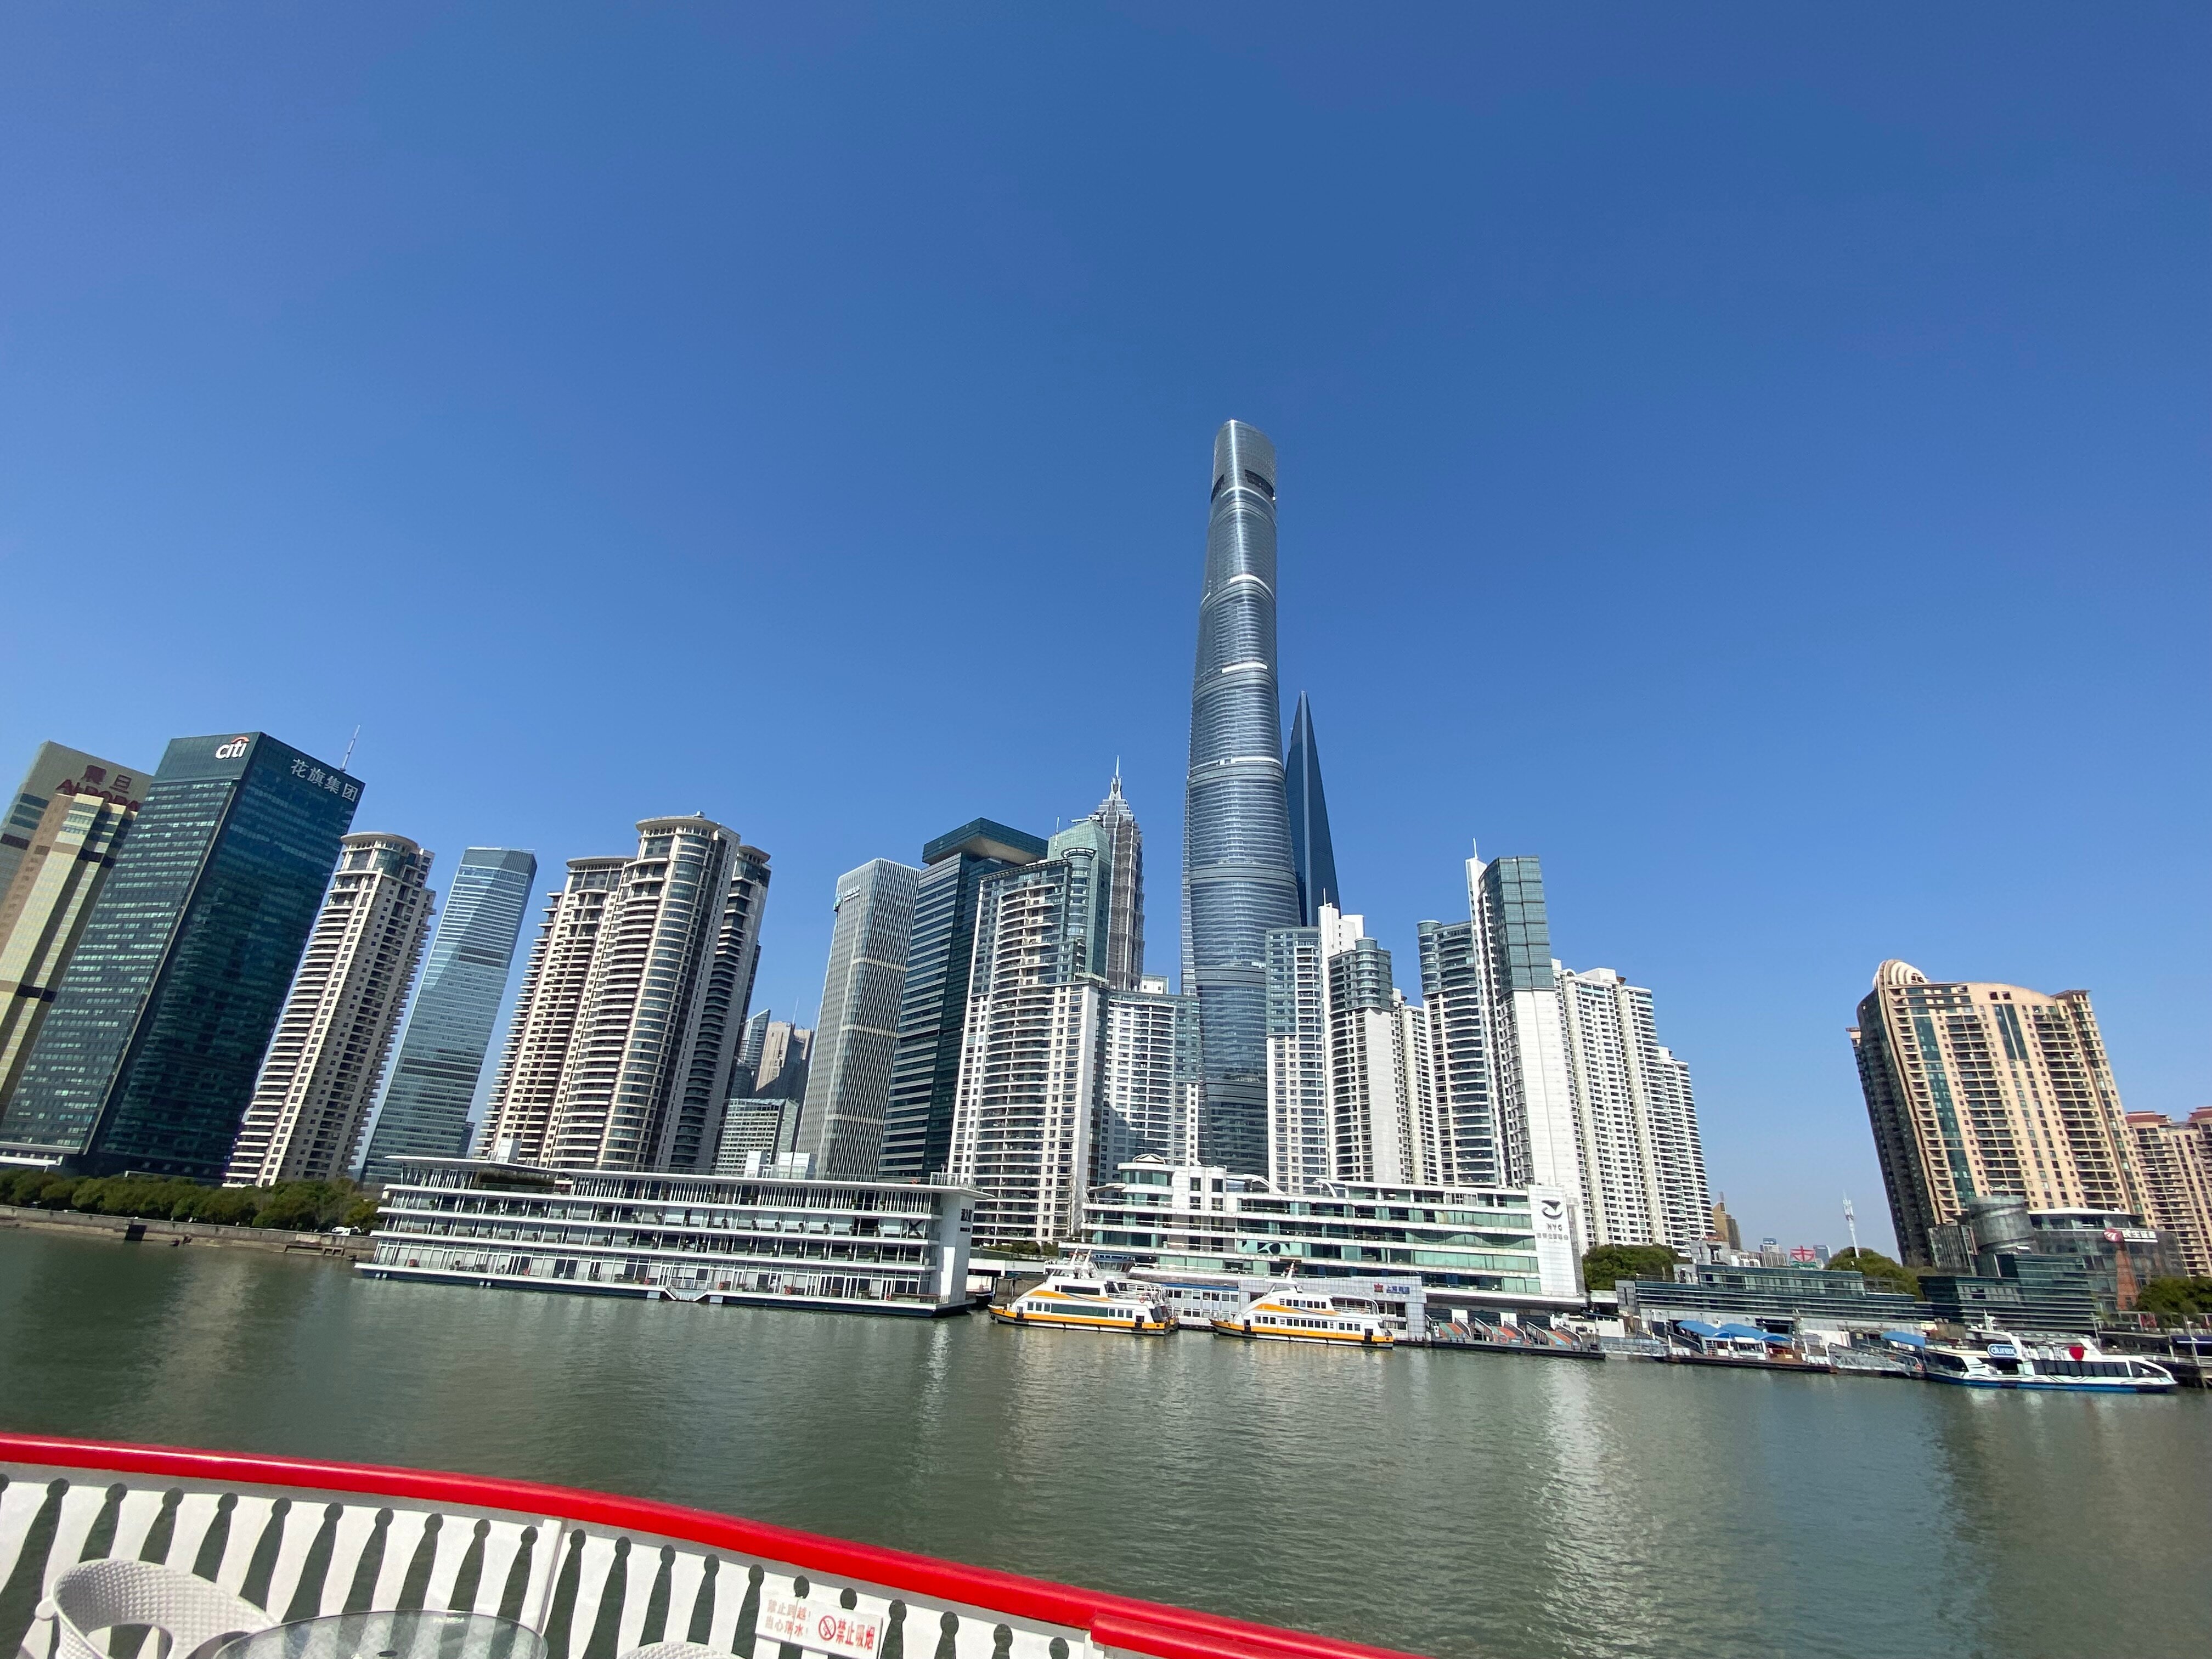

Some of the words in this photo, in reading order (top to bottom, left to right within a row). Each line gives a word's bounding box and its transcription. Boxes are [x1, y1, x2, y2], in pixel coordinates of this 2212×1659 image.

[215, 738, 249, 759] citi
[290, 759, 359, 802] 花旗集团
[1990, 1346, 2016, 1356] durex
[836, 1618, 876, 1650] 禁止吸烟
